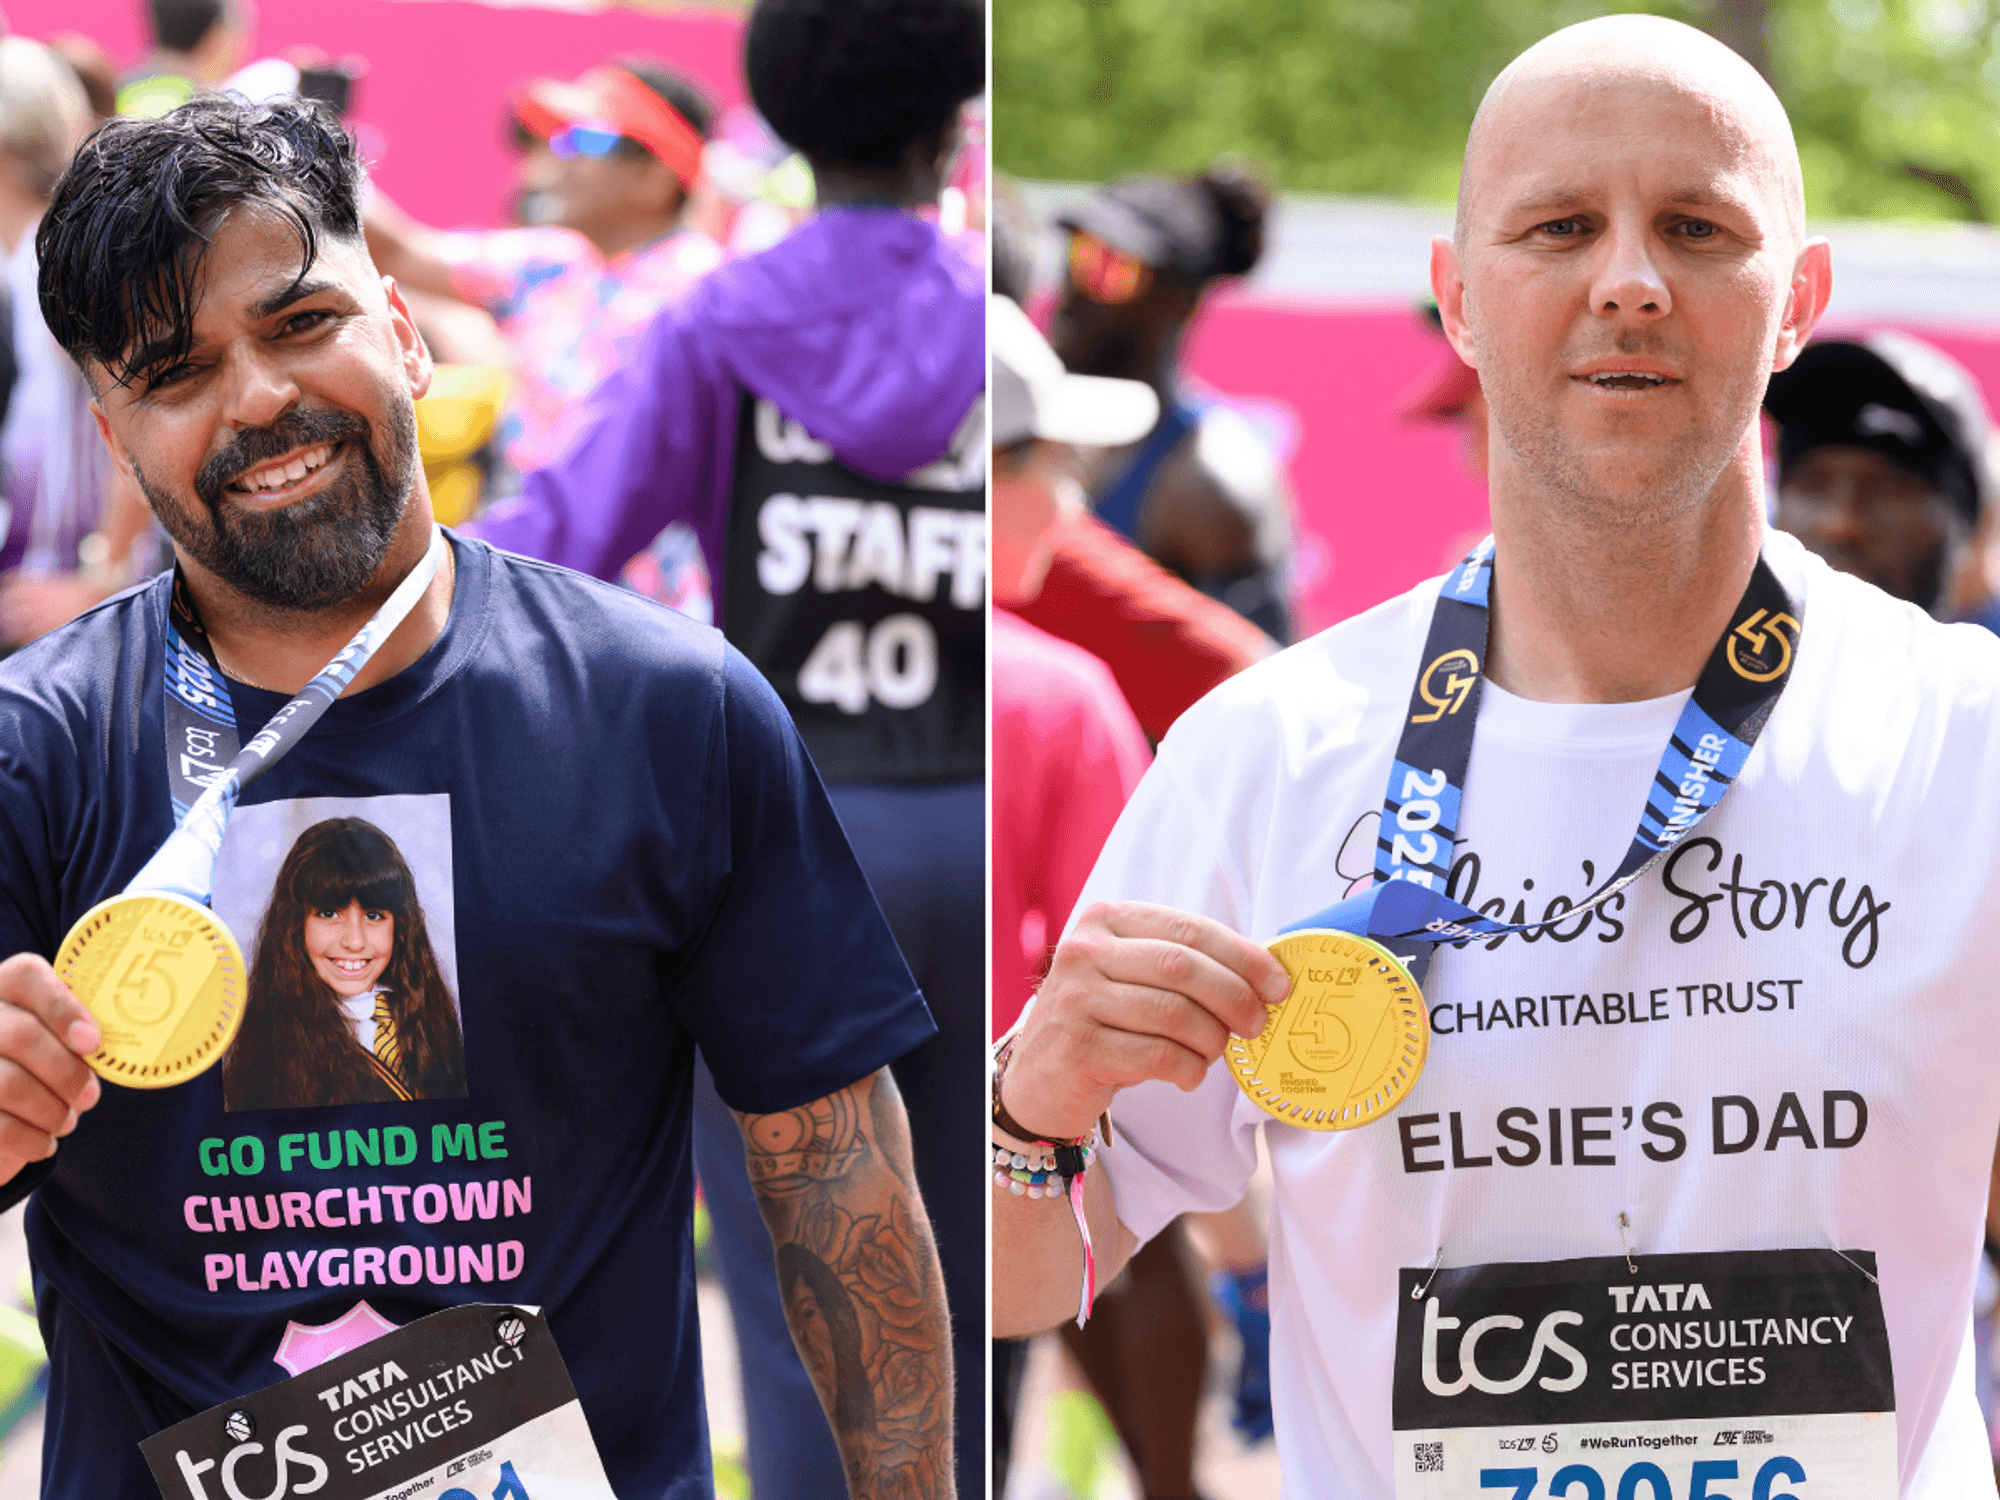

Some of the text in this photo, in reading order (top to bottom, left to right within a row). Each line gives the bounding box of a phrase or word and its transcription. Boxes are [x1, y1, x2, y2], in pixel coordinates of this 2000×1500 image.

[178, 637, 217, 708] 2025
[797, 611, 939, 715] 40
[185, 726, 221, 757] tcs
[1657, 733, 1728, 843] FINISHER
[1444, 836, 1891, 969] lsie's Story
[1430, 979, 1803, 1035] CHARITABLE TRUST
[199, 1120, 509, 1176] GO FUND ME
[1398, 1090, 1868, 1173] ELSIE'S DAD
[183, 1175, 532, 1232] CHURCHTOWN
[204, 1240, 525, 1292] PLAYGROUND
[1608, 1283, 1712, 1314] TATA
[1421, 1296, 1588, 1397] tcs
[1609, 1315, 1855, 1352] CONSULTANCY
[317, 1360, 409, 1412] TATA
[333, 1345, 524, 1442] CONSULTANCY
[1611, 1356, 1767, 1391] SERVICES
[175, 1424, 329, 1500] tcs
[346, 1399, 474, 1475] SERVICES
[1580, 1433, 1699, 1449] #WeRunTogether
